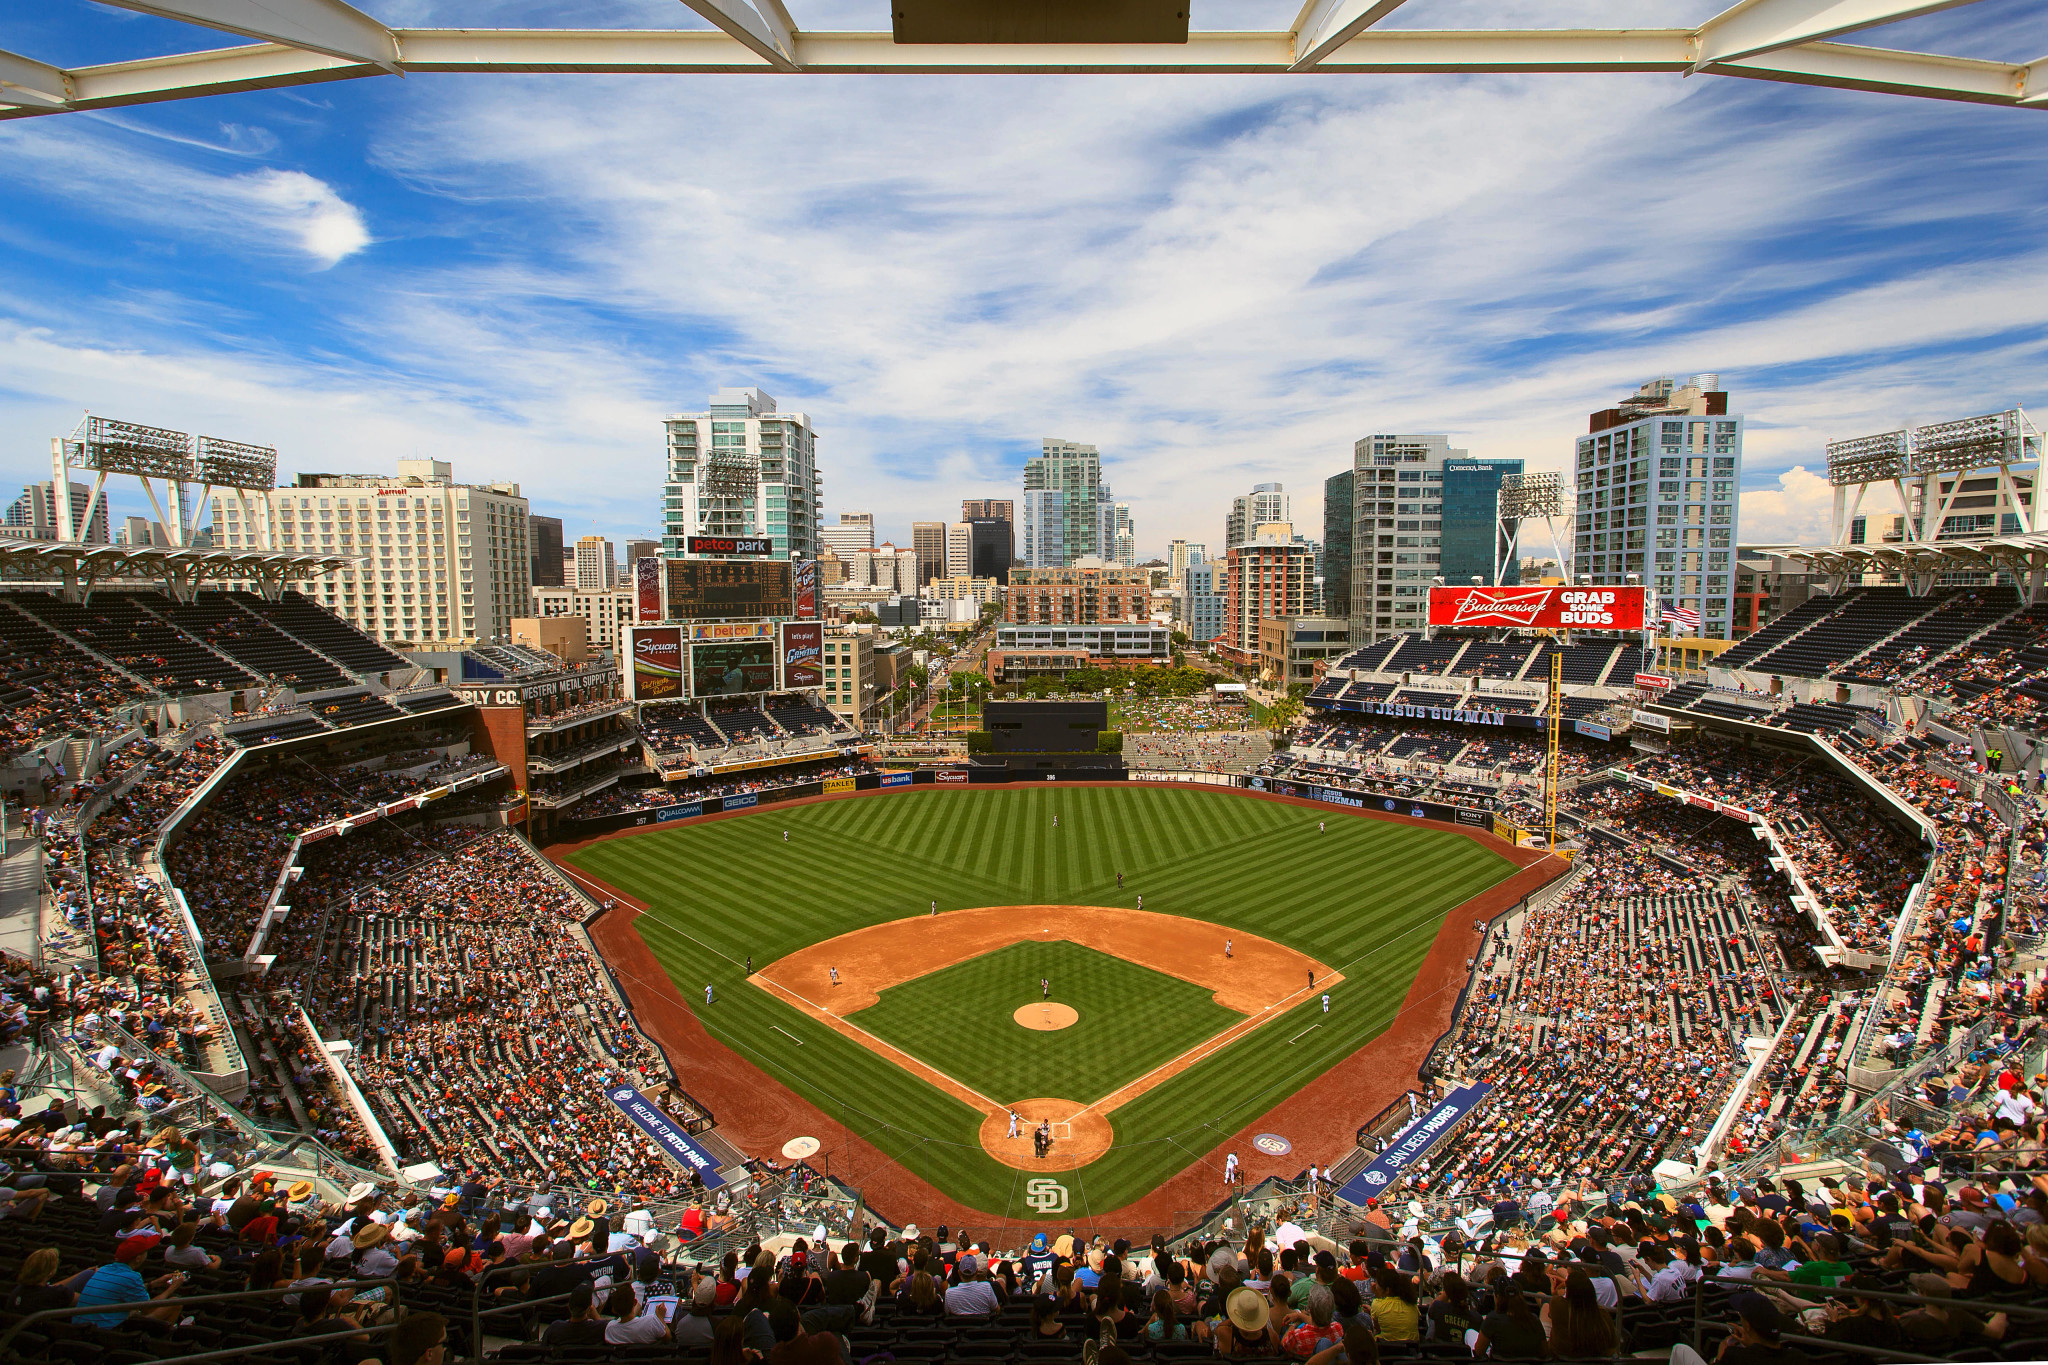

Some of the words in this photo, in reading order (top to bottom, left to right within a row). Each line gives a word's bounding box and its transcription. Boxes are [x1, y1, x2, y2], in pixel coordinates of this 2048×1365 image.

[695, 539, 734, 552] petco
[737, 541, 765, 553] park
[1561, 592, 1615, 604] GRAB
[1456, 596, 1546, 613] Budweiser
[1570, 604, 1604, 612] SOME
[1561, 612, 1613, 624] BUDS
[714, 626, 748, 637] petco
[636, 638, 678, 655] Sycuan
[522, 683, 557, 700] WESTERN
[560, 677, 582, 693] METAL
[582, 672, 606, 688] SUPPLY
[607, 670, 618, 682] CO.
[496, 690, 521, 704] CO.
[1376, 703, 1425, 718] JESUS
[1430, 708, 1504, 726] GUZMAN
[823, 780, 855, 789] STANLEY
[1323, 789, 1342, 797] JESUS
[725, 797, 756, 808] GEICO
[1322, 794, 1363, 808] GUZMAN
[658, 806, 701, 820] QUALCOMM
[1460, 811, 1482, 819] SONY
[1730, 810, 1747, 820] TOYOTA
[357, 814, 376, 825] TOYOTA
[636, 817, 647, 825] 357
[313, 827, 334, 839] TOYOTA
[630, 1101, 660, 1128] WELCOME
[656, 1126, 670, 1135] TO
[664, 1132, 690, 1153] PETCO
[684, 1150, 710, 1169] PARK
[1385, 1148, 1410, 1167] SAN
[1401, 1130, 1431, 1152] DIEGO
[1423, 1105, 1459, 1133] PADRES
[1026, 1178, 1068, 1213] SD
[590, 1265, 613, 1278] MAYBIN
[1032, 1261, 1052, 1270] MAYBIN
[1444, 1314, 1469, 1329] GREENE
